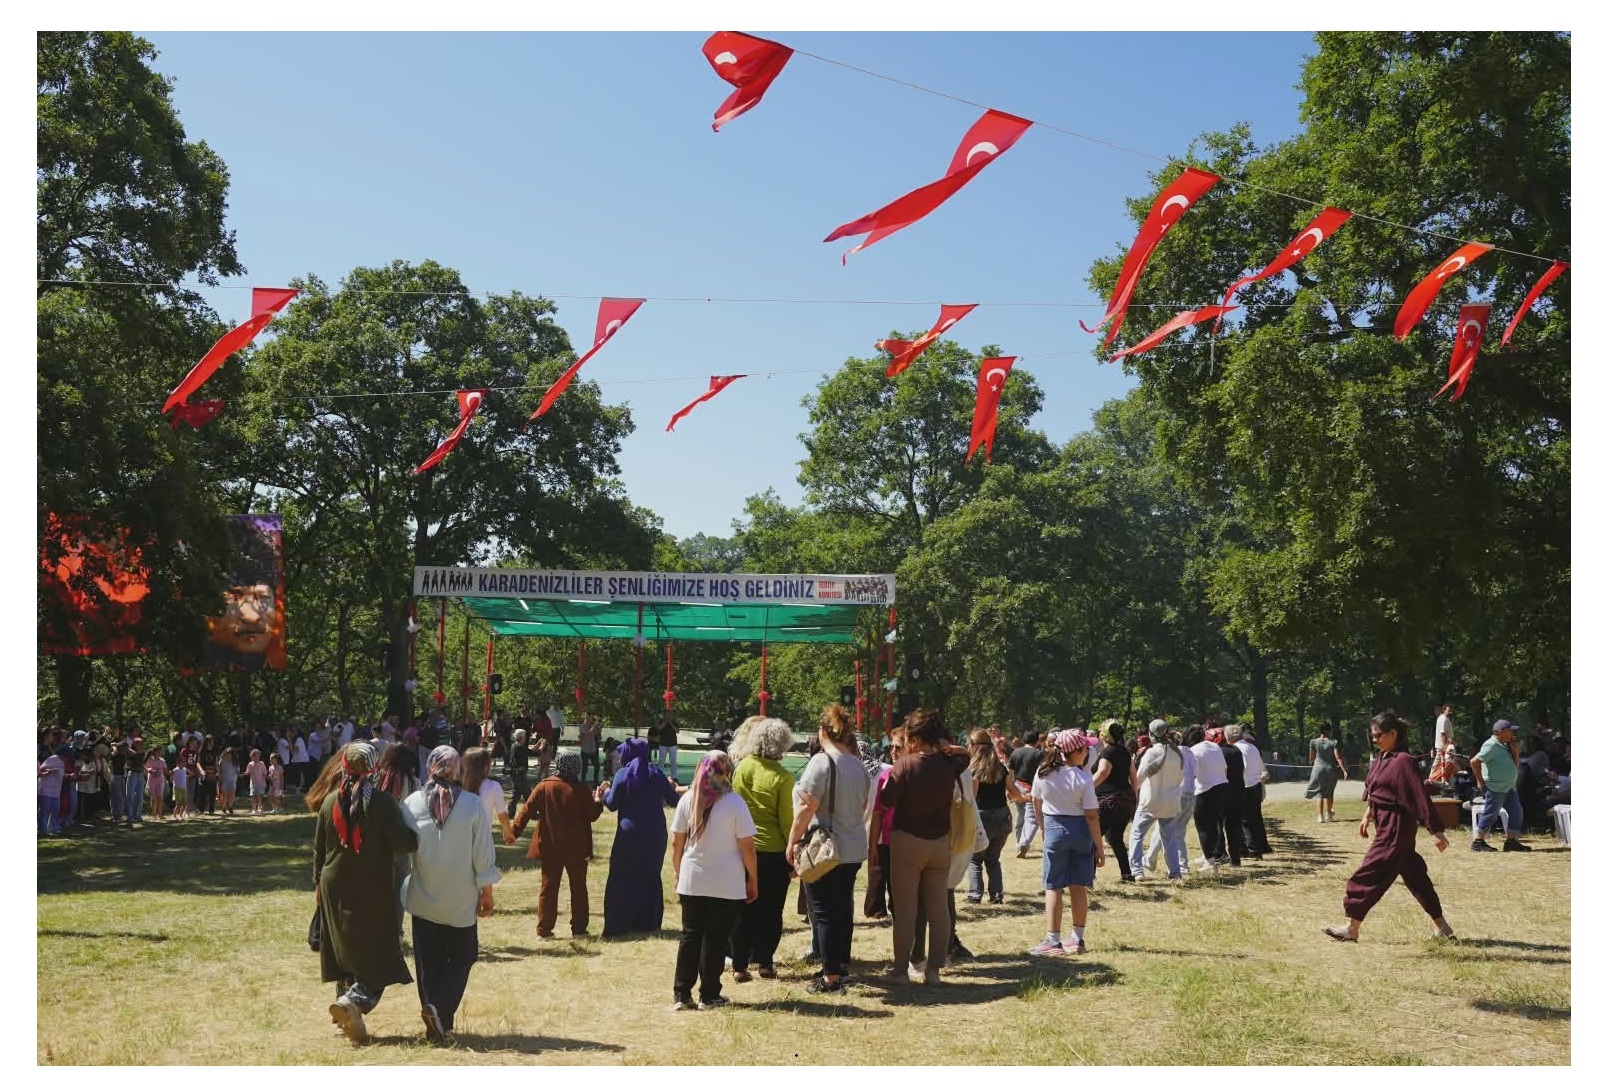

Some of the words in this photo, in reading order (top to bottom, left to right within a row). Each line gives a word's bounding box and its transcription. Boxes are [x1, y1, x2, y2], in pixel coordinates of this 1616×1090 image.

[478, 572, 603, 595] KARADENİZLİLER
[608, 574, 704, 598] ŞENLİĞİMİZE
[709, 579, 740, 601] HOŞ
[745, 576, 814, 598] GELDİNİZ
[188, 753, 197, 763] 24
